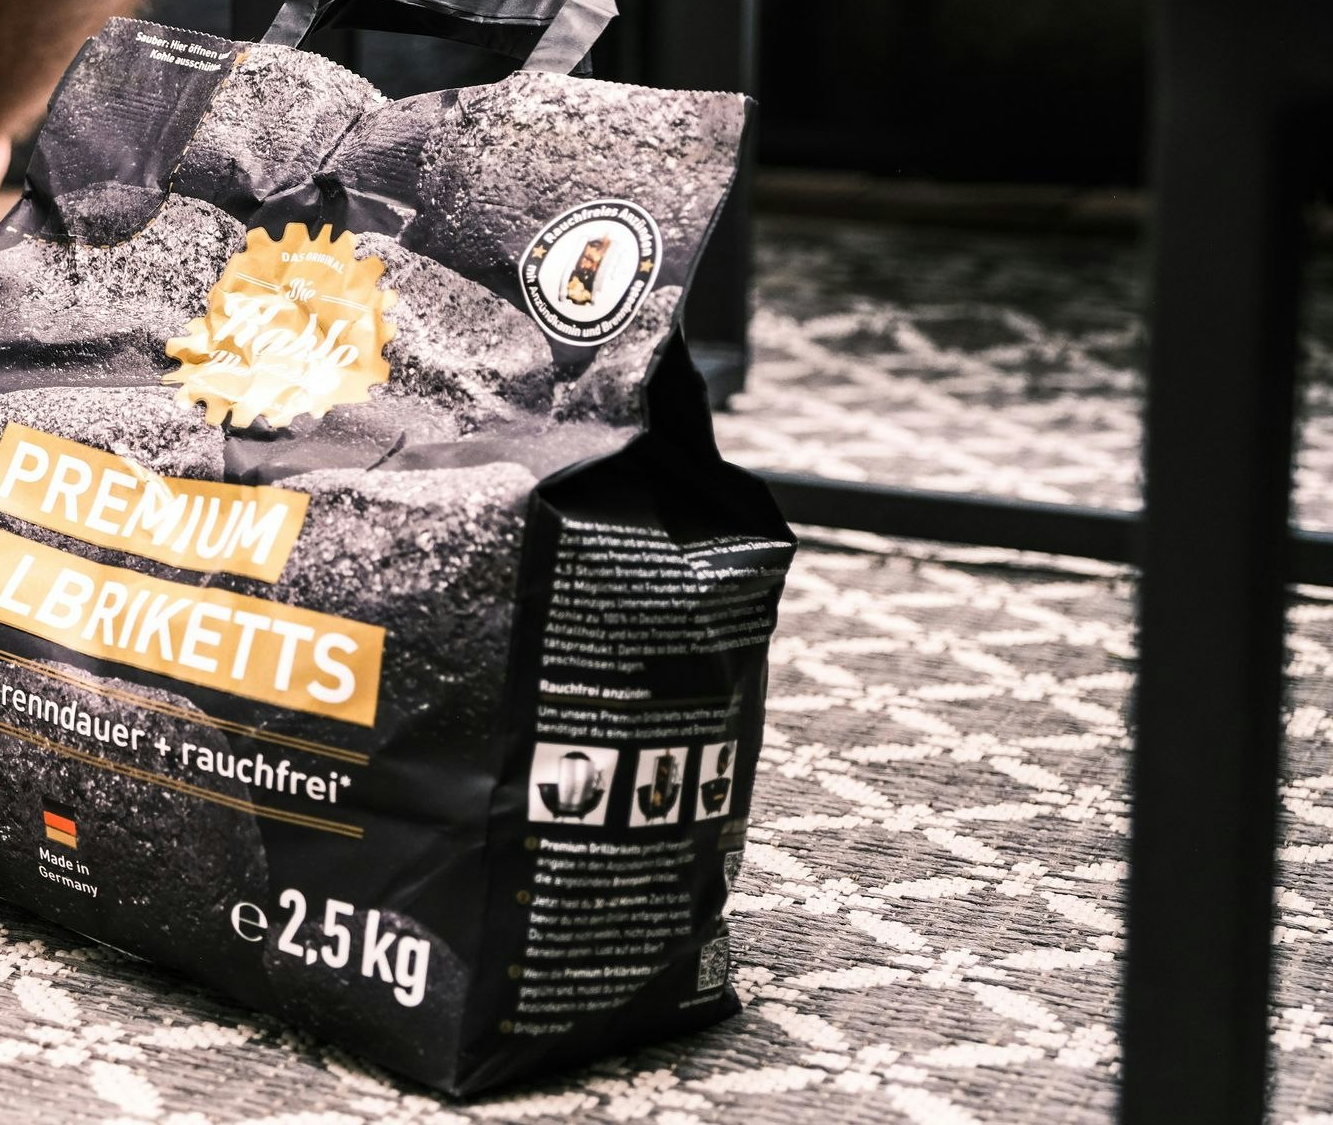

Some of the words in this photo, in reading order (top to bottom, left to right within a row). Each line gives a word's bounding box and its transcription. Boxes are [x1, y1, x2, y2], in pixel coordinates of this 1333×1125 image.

[136, 31, 170, 48] Sauber:
[170, 40, 188, 52] Hier
[188, 44, 217, 59] öffnen
[150, 49, 175, 63] Kohle
[543, 205, 619, 244] Rauchfreies
[281, 252, 306, 263] DAS
[305, 251, 345, 274] ORIGINAL
[526, 264, 537, 283] mit
[529, 286, 582, 337] Anzündkamin
[582, 325, 601, 338] und
[539, 678, 600, 697] Rauchfrei
[538, 706, 558, 718] Um
[39, 847, 73, 872] Made
[76, 861, 90, 876] in
[38, 865, 99, 899] Germany
[277, 888, 355, 970] 2,5
[362, 909, 432, 1007] kg
